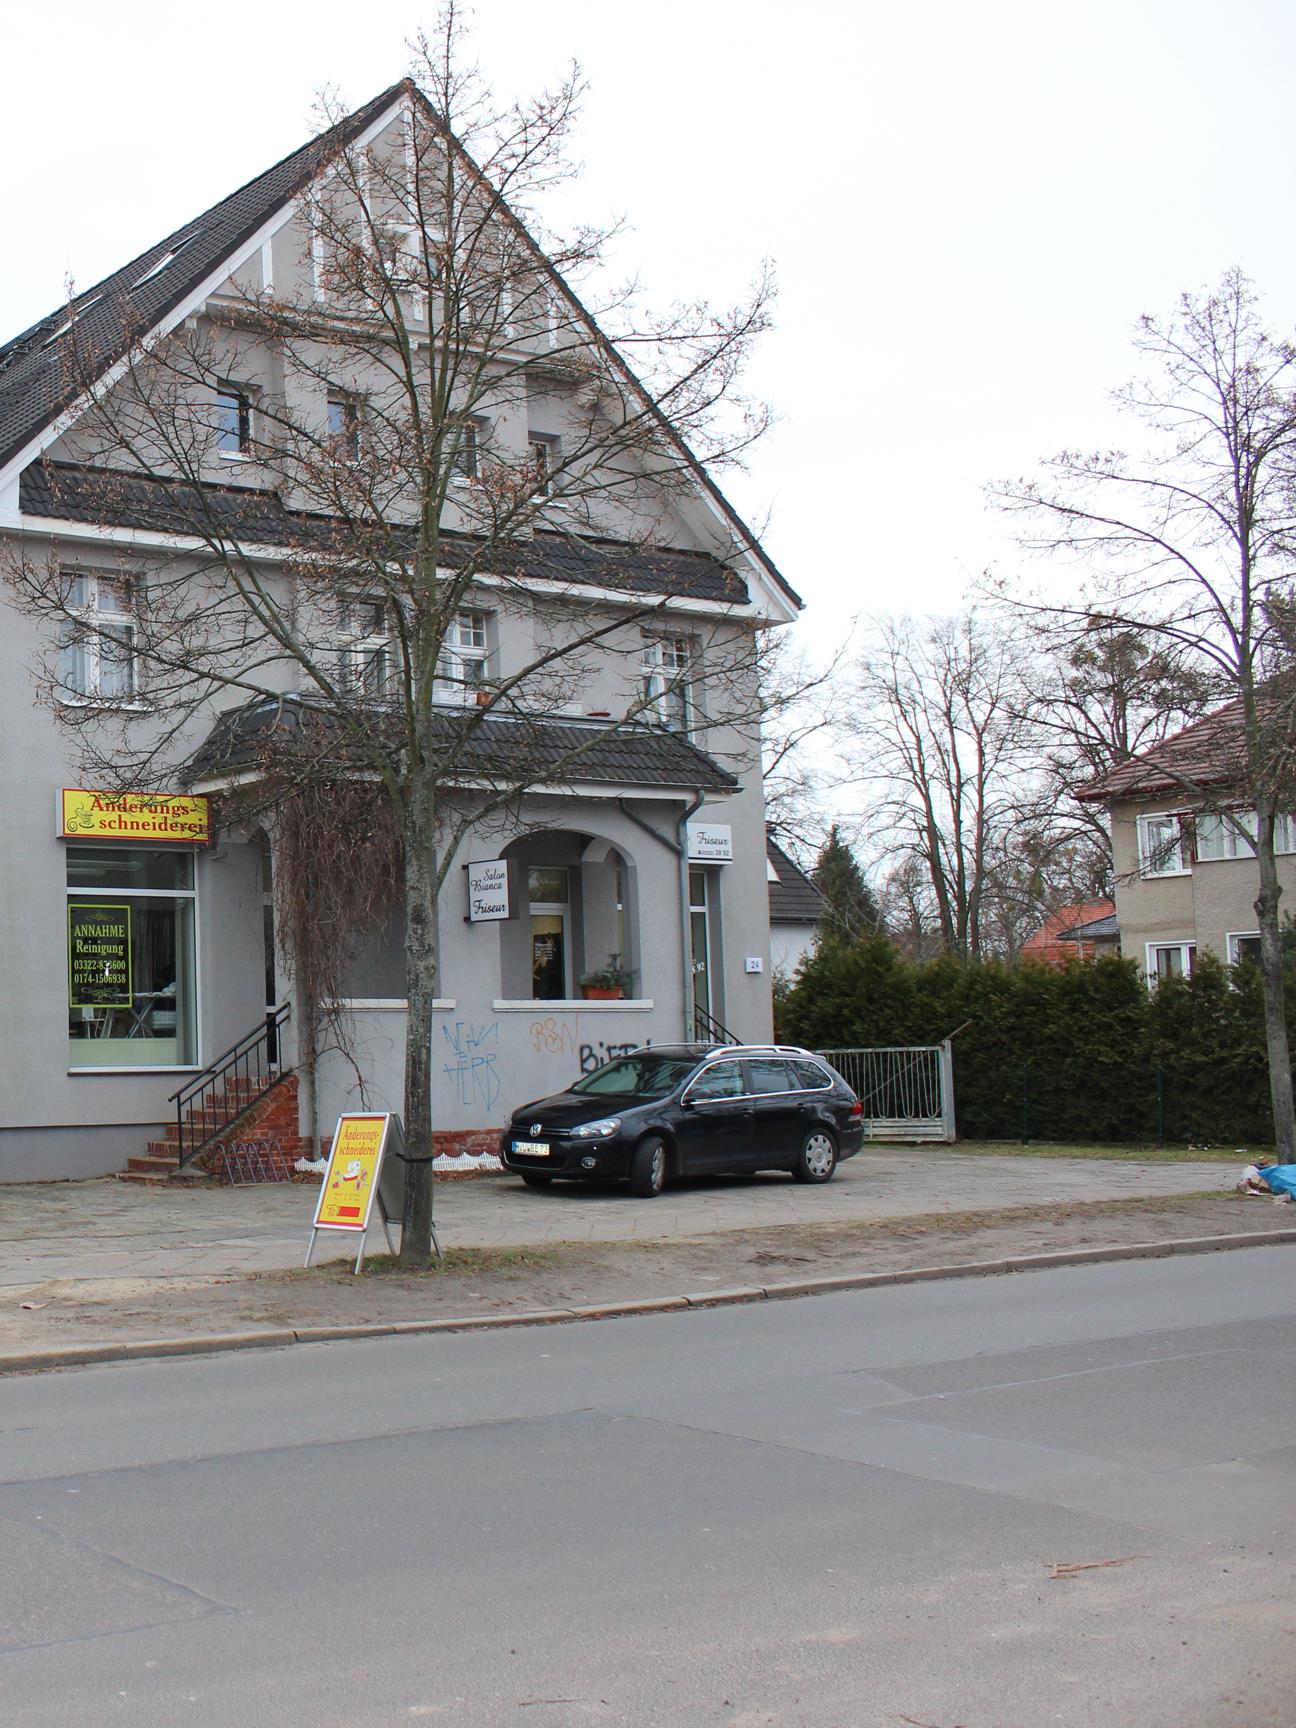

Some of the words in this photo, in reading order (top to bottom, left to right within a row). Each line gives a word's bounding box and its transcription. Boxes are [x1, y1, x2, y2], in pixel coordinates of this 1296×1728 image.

[99, 815, 209, 834] schneiderei
[696, 831, 729, 845] Friseur
[484, 868, 505, 881] Salon
[471, 879, 502, 892] Bianca
[473, 899, 506, 914] Friseur
[74, 924, 125, 938] ANNAHME
[76, 939, 124, 956] Reinigung
[750, 960, 760, 969] 24
